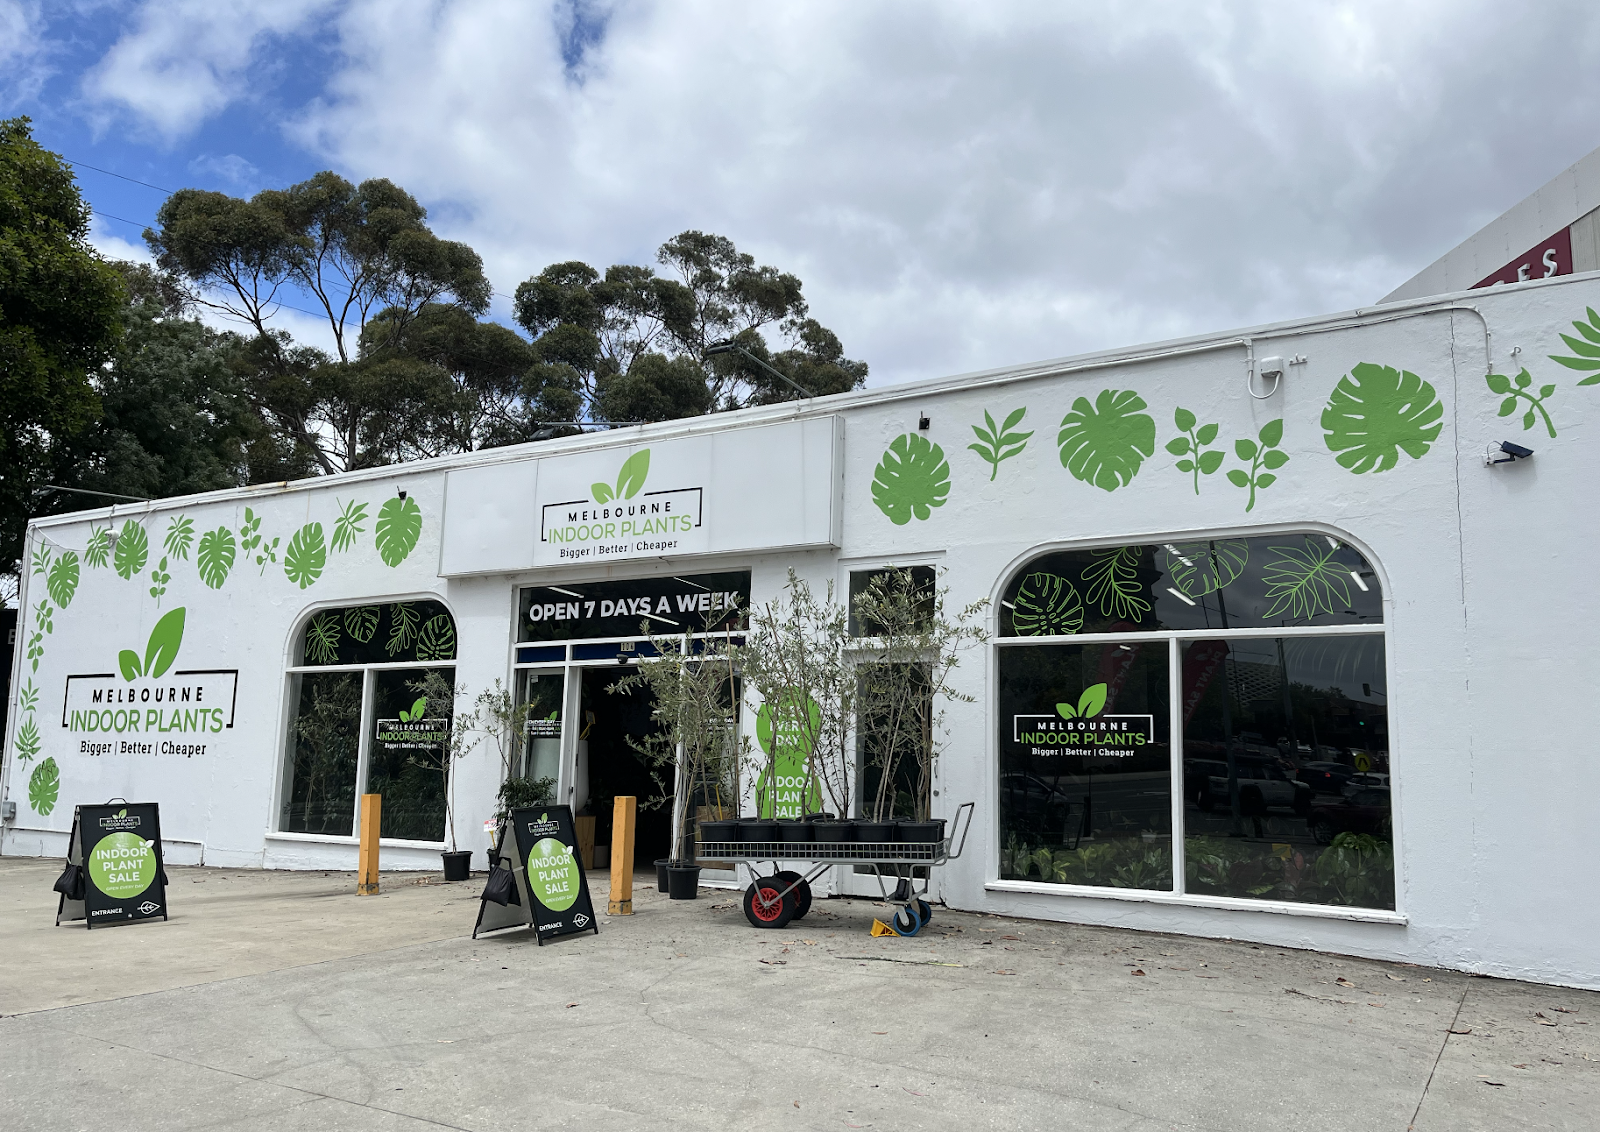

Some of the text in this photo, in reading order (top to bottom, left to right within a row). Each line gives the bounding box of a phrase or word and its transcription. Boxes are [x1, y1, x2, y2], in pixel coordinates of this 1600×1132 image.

[568, 502, 671, 522] MELBOURNE
[548, 514, 692, 544] INDOOR PLANTS
[560, 547, 590, 558] Bigger
[599, 543, 628, 555] Better
[636, 539, 678, 552] Cheaper
[529, 591, 739, 622] OPEN 7 DAYS A WEEK
[92, 687, 203, 703] MELBOURNE
[69, 707, 224, 733] INDOOR PLANTS
[1038, 722, 1128, 730] MELBOURNE
[380, 732, 410, 741] INDOOR
[776, 735, 800, 746] DAY
[1020, 732, 1146, 746] INDOOR PLANTS
[80, 740, 112, 756] Bigger
[120, 741, 152, 755] Better
[161, 741, 207, 758] Cheaper
[1032, 747, 1059, 756] Bigger
[1065, 748, 1091, 756] Better
[1099, 748, 1134, 757] Cheaper
[766, 775, 813, 788] NDOOR
[775, 805, 802, 818] SALE
[97, 847, 148, 860] INDOOR
[103, 859, 144, 872] PLANT
[532, 855, 571, 869] INDOOR
[109, 871, 140, 884] SALE
[538, 867, 569, 882] PLANT
[545, 881, 569, 894] SALE
[91, 908, 123, 916] ENTRANCE
